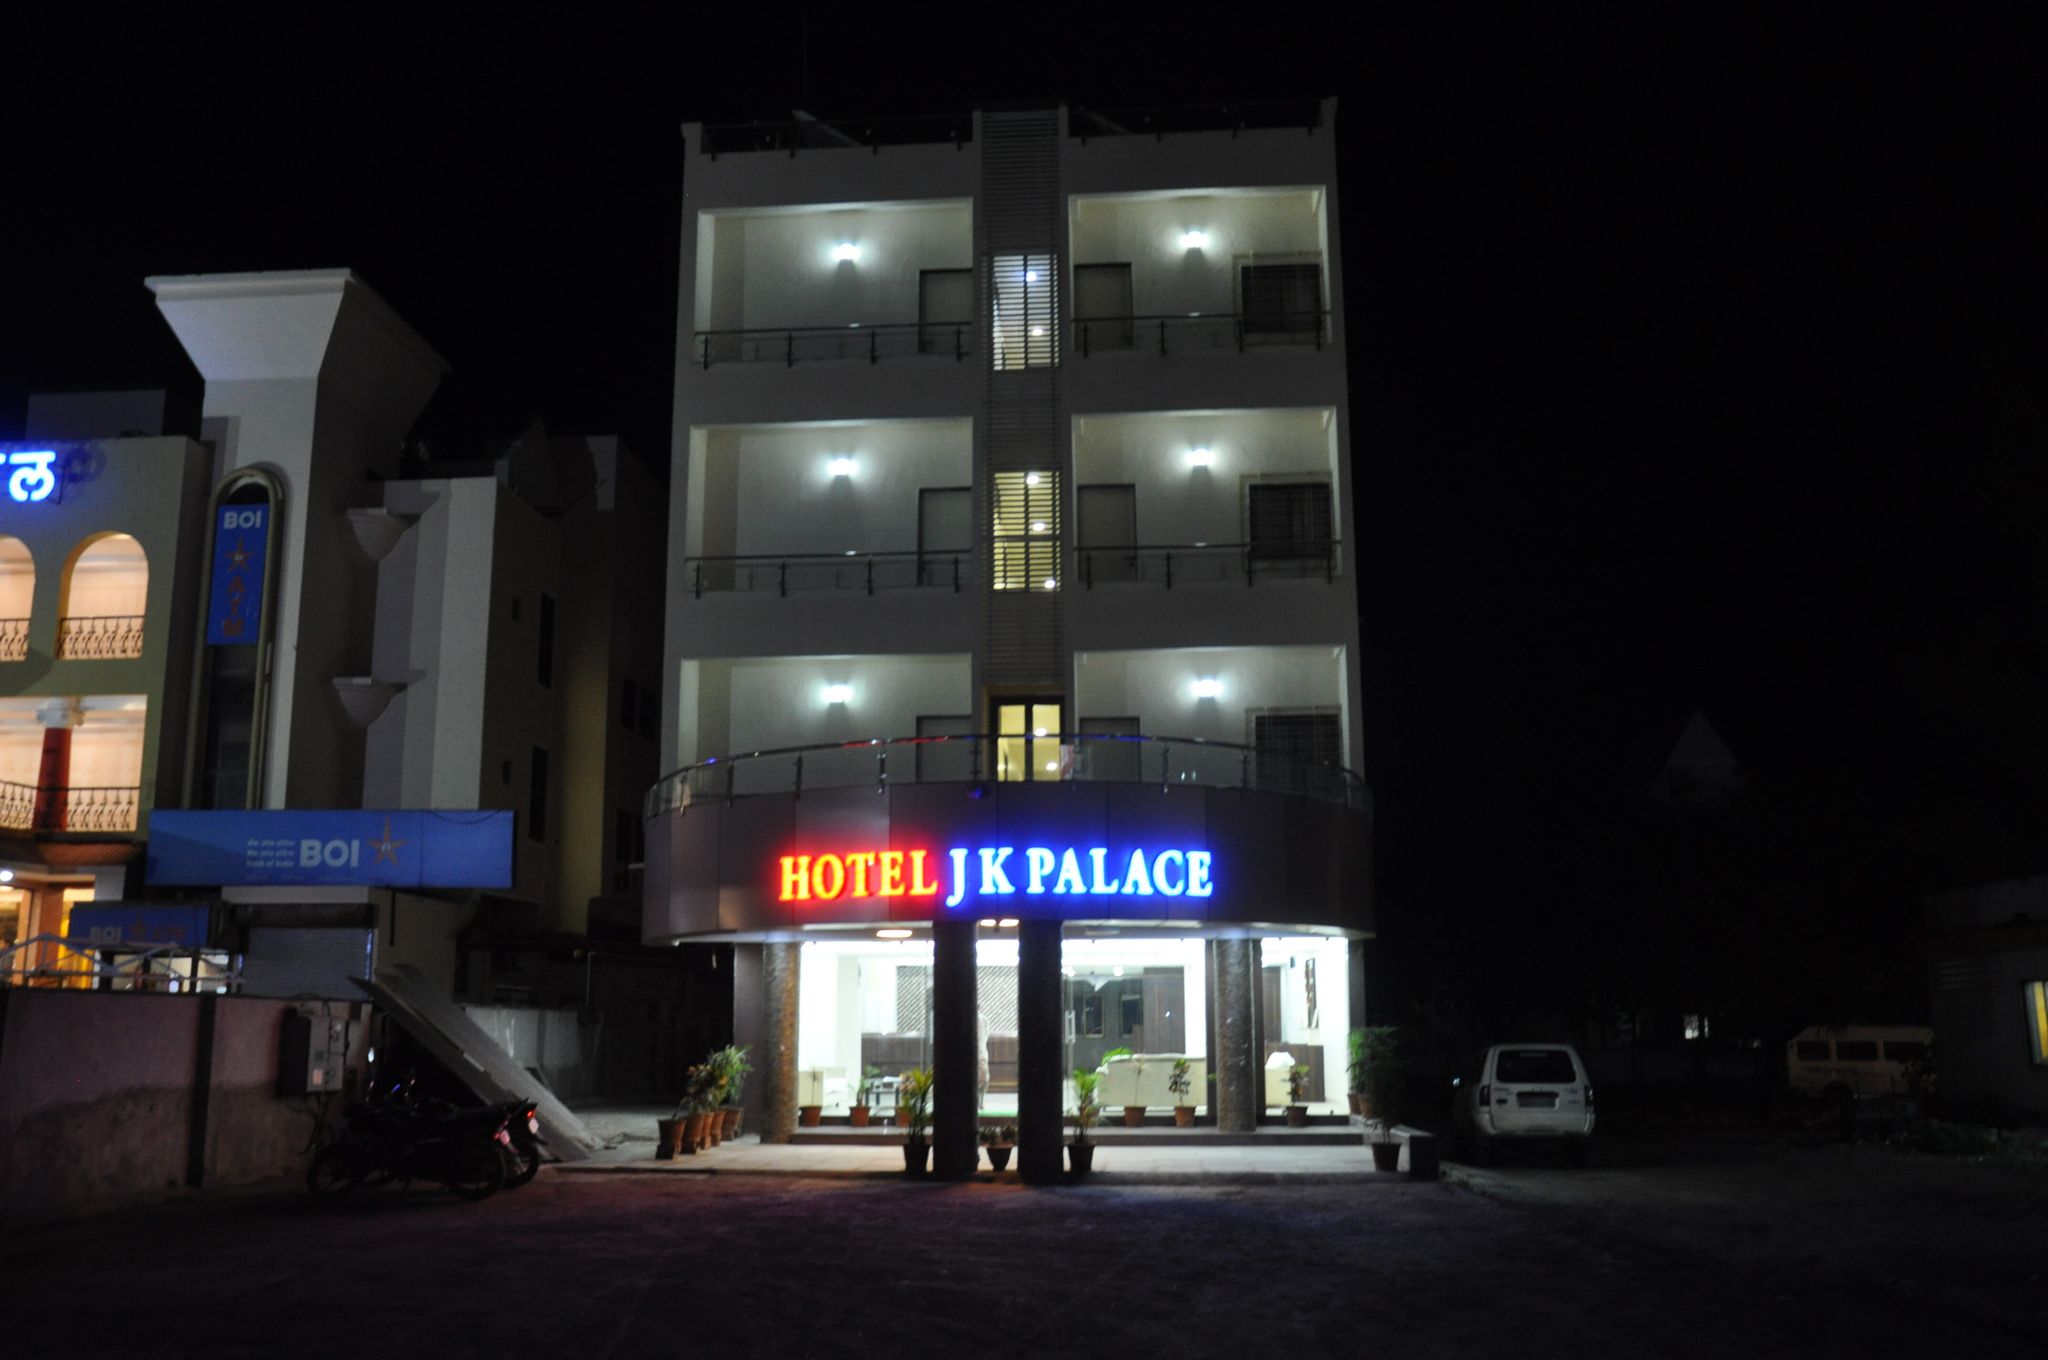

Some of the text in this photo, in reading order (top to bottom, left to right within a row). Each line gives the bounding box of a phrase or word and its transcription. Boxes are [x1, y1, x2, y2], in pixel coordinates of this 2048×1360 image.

[223, 510, 262, 529] BOI
[300, 838, 360, 868] BOI
[778, 849, 938, 900] HOTEL
[1025, 847, 1213, 897] PALACE
